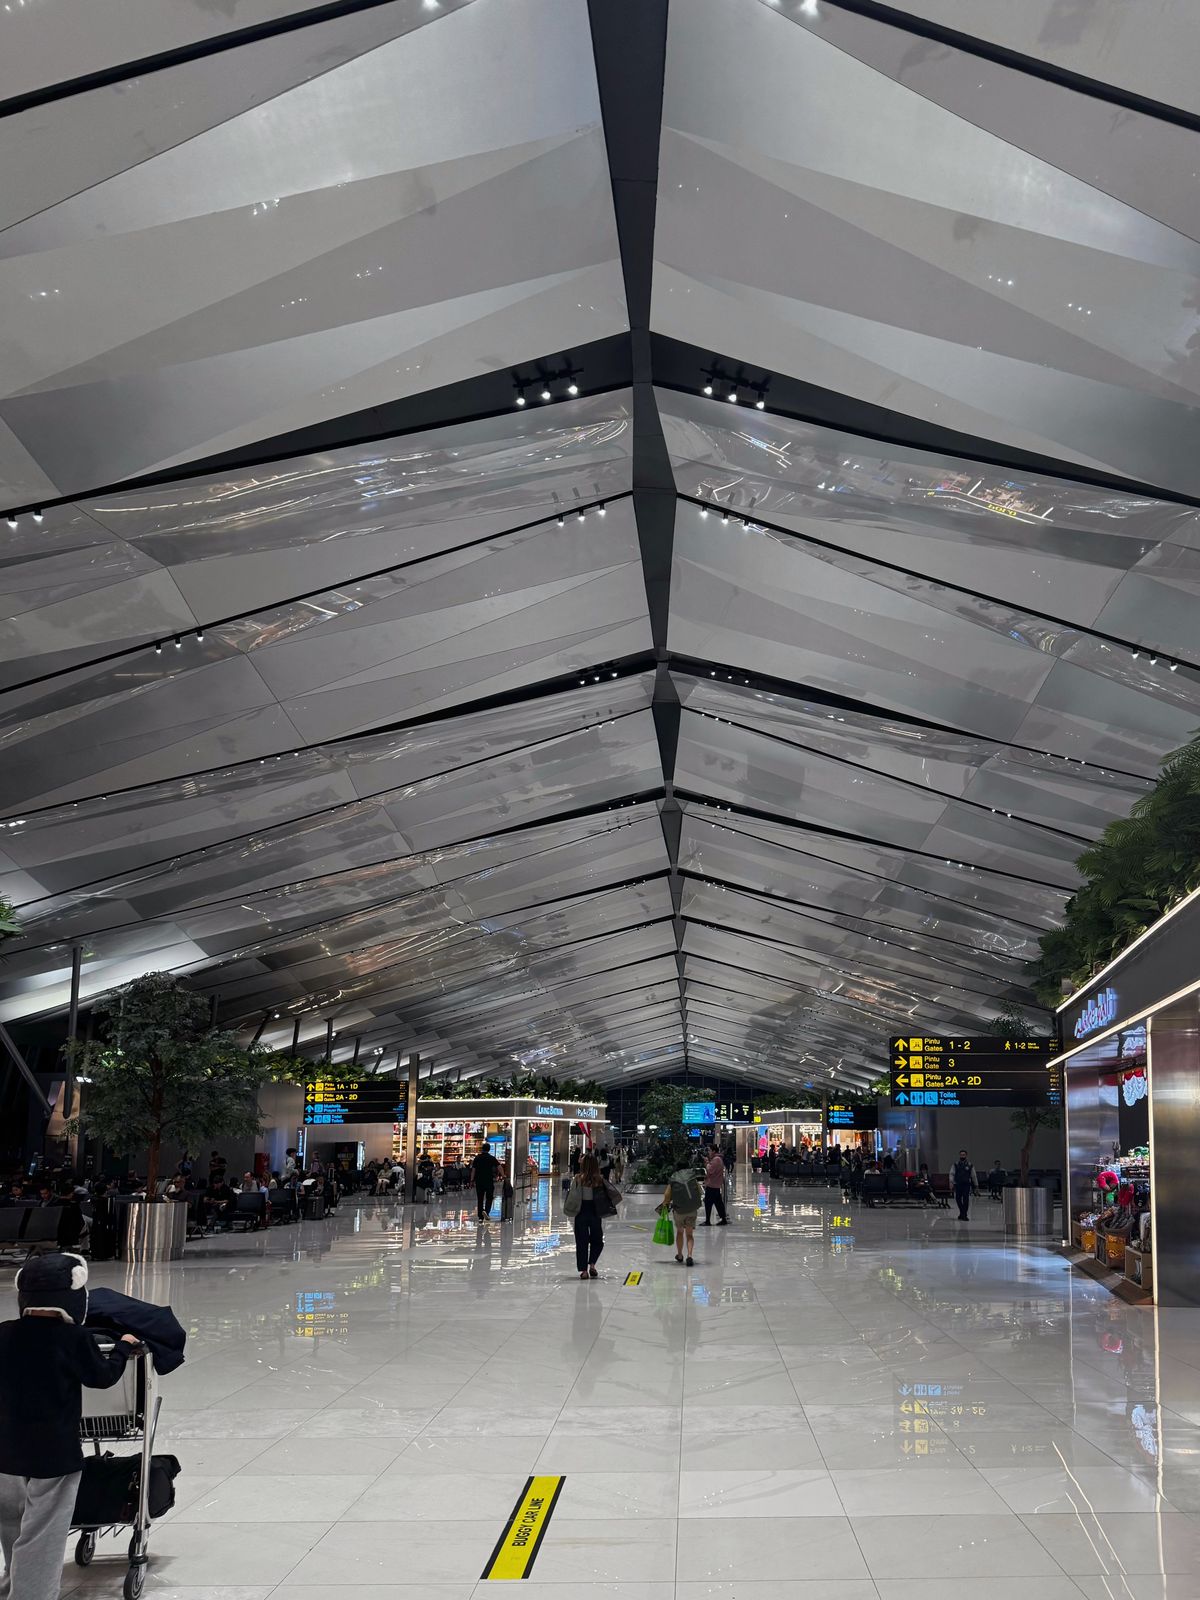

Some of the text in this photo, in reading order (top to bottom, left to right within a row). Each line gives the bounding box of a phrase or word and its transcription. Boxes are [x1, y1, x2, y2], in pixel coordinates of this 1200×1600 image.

[949, 1041, 954, 1050] 1
[964, 1041, 970, 1050] 2
[948, 1058, 955, 1067] 3
[945, 1076, 959, 1085] 2A
[967, 1076, 982, 1085] 2D
[512, 1498, 544, 1546] BUGGY CAR LINE
